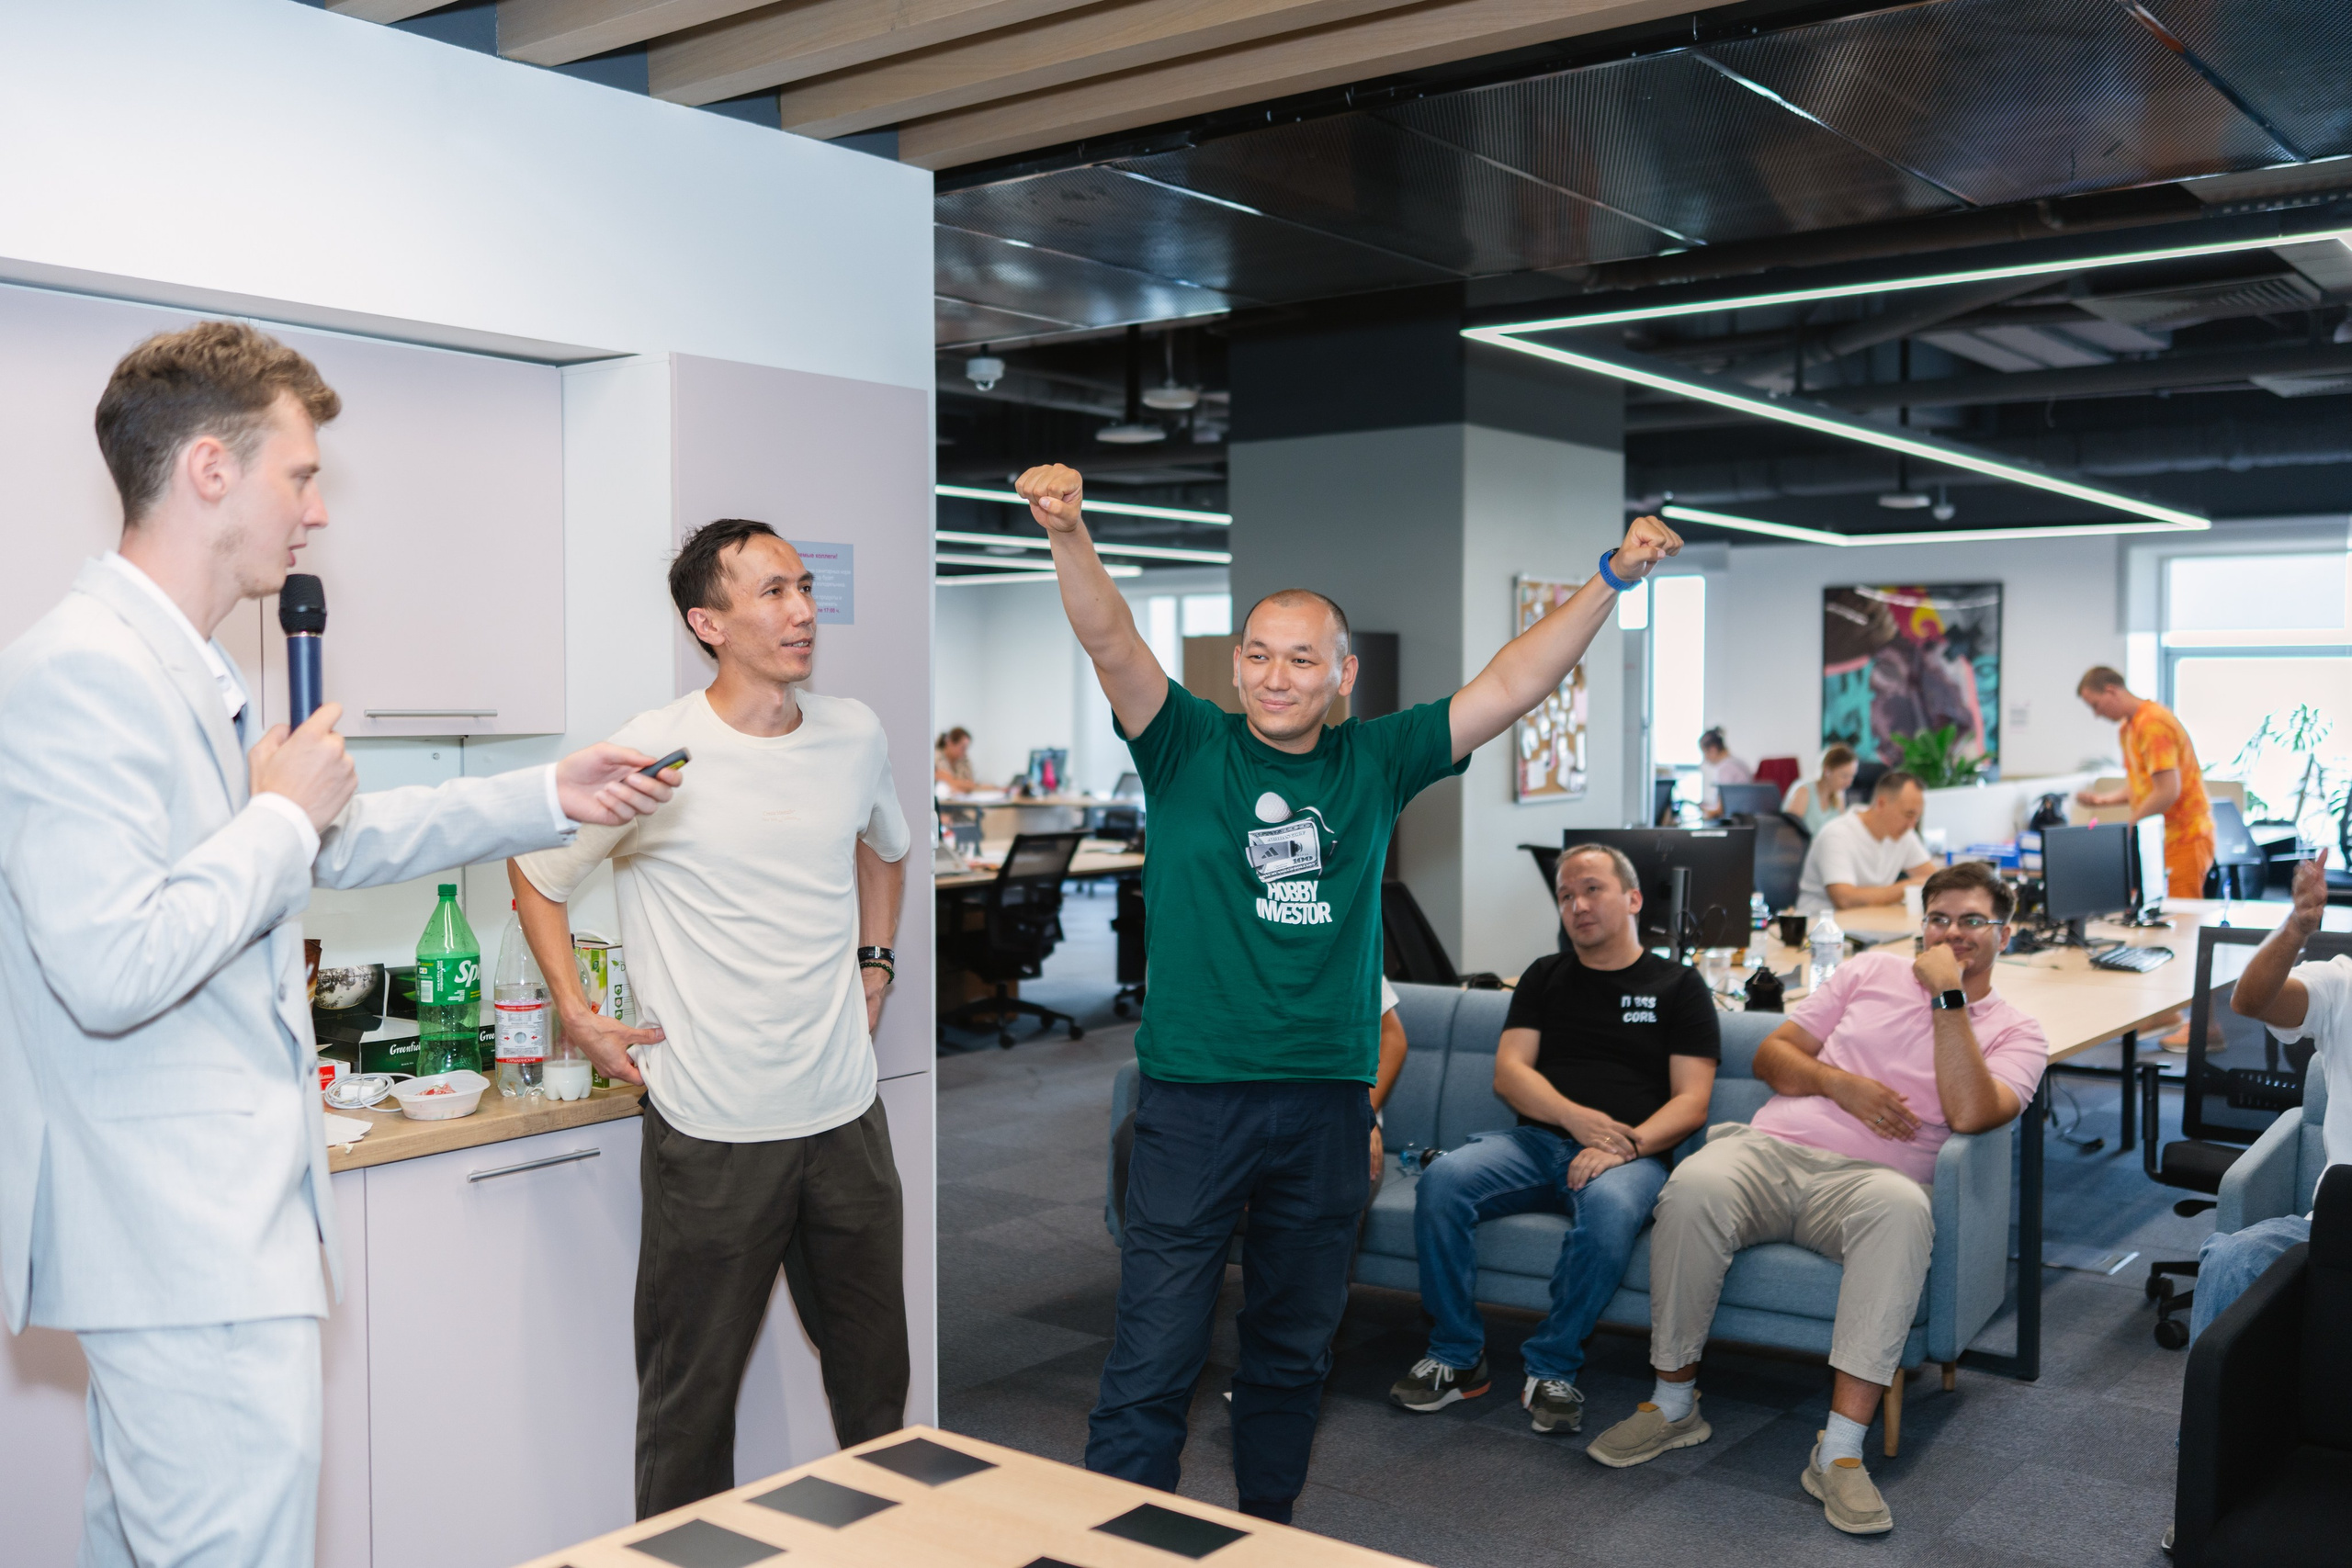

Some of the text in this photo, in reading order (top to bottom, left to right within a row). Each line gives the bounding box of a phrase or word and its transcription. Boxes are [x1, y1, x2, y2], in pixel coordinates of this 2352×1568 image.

[1293, 855, 1314, 864] 100
[1267, 880, 1318, 902] HOBBY
[1256, 897, 1333, 925] INVESTOR
[1623, 1011, 1657, 1023] CORE
